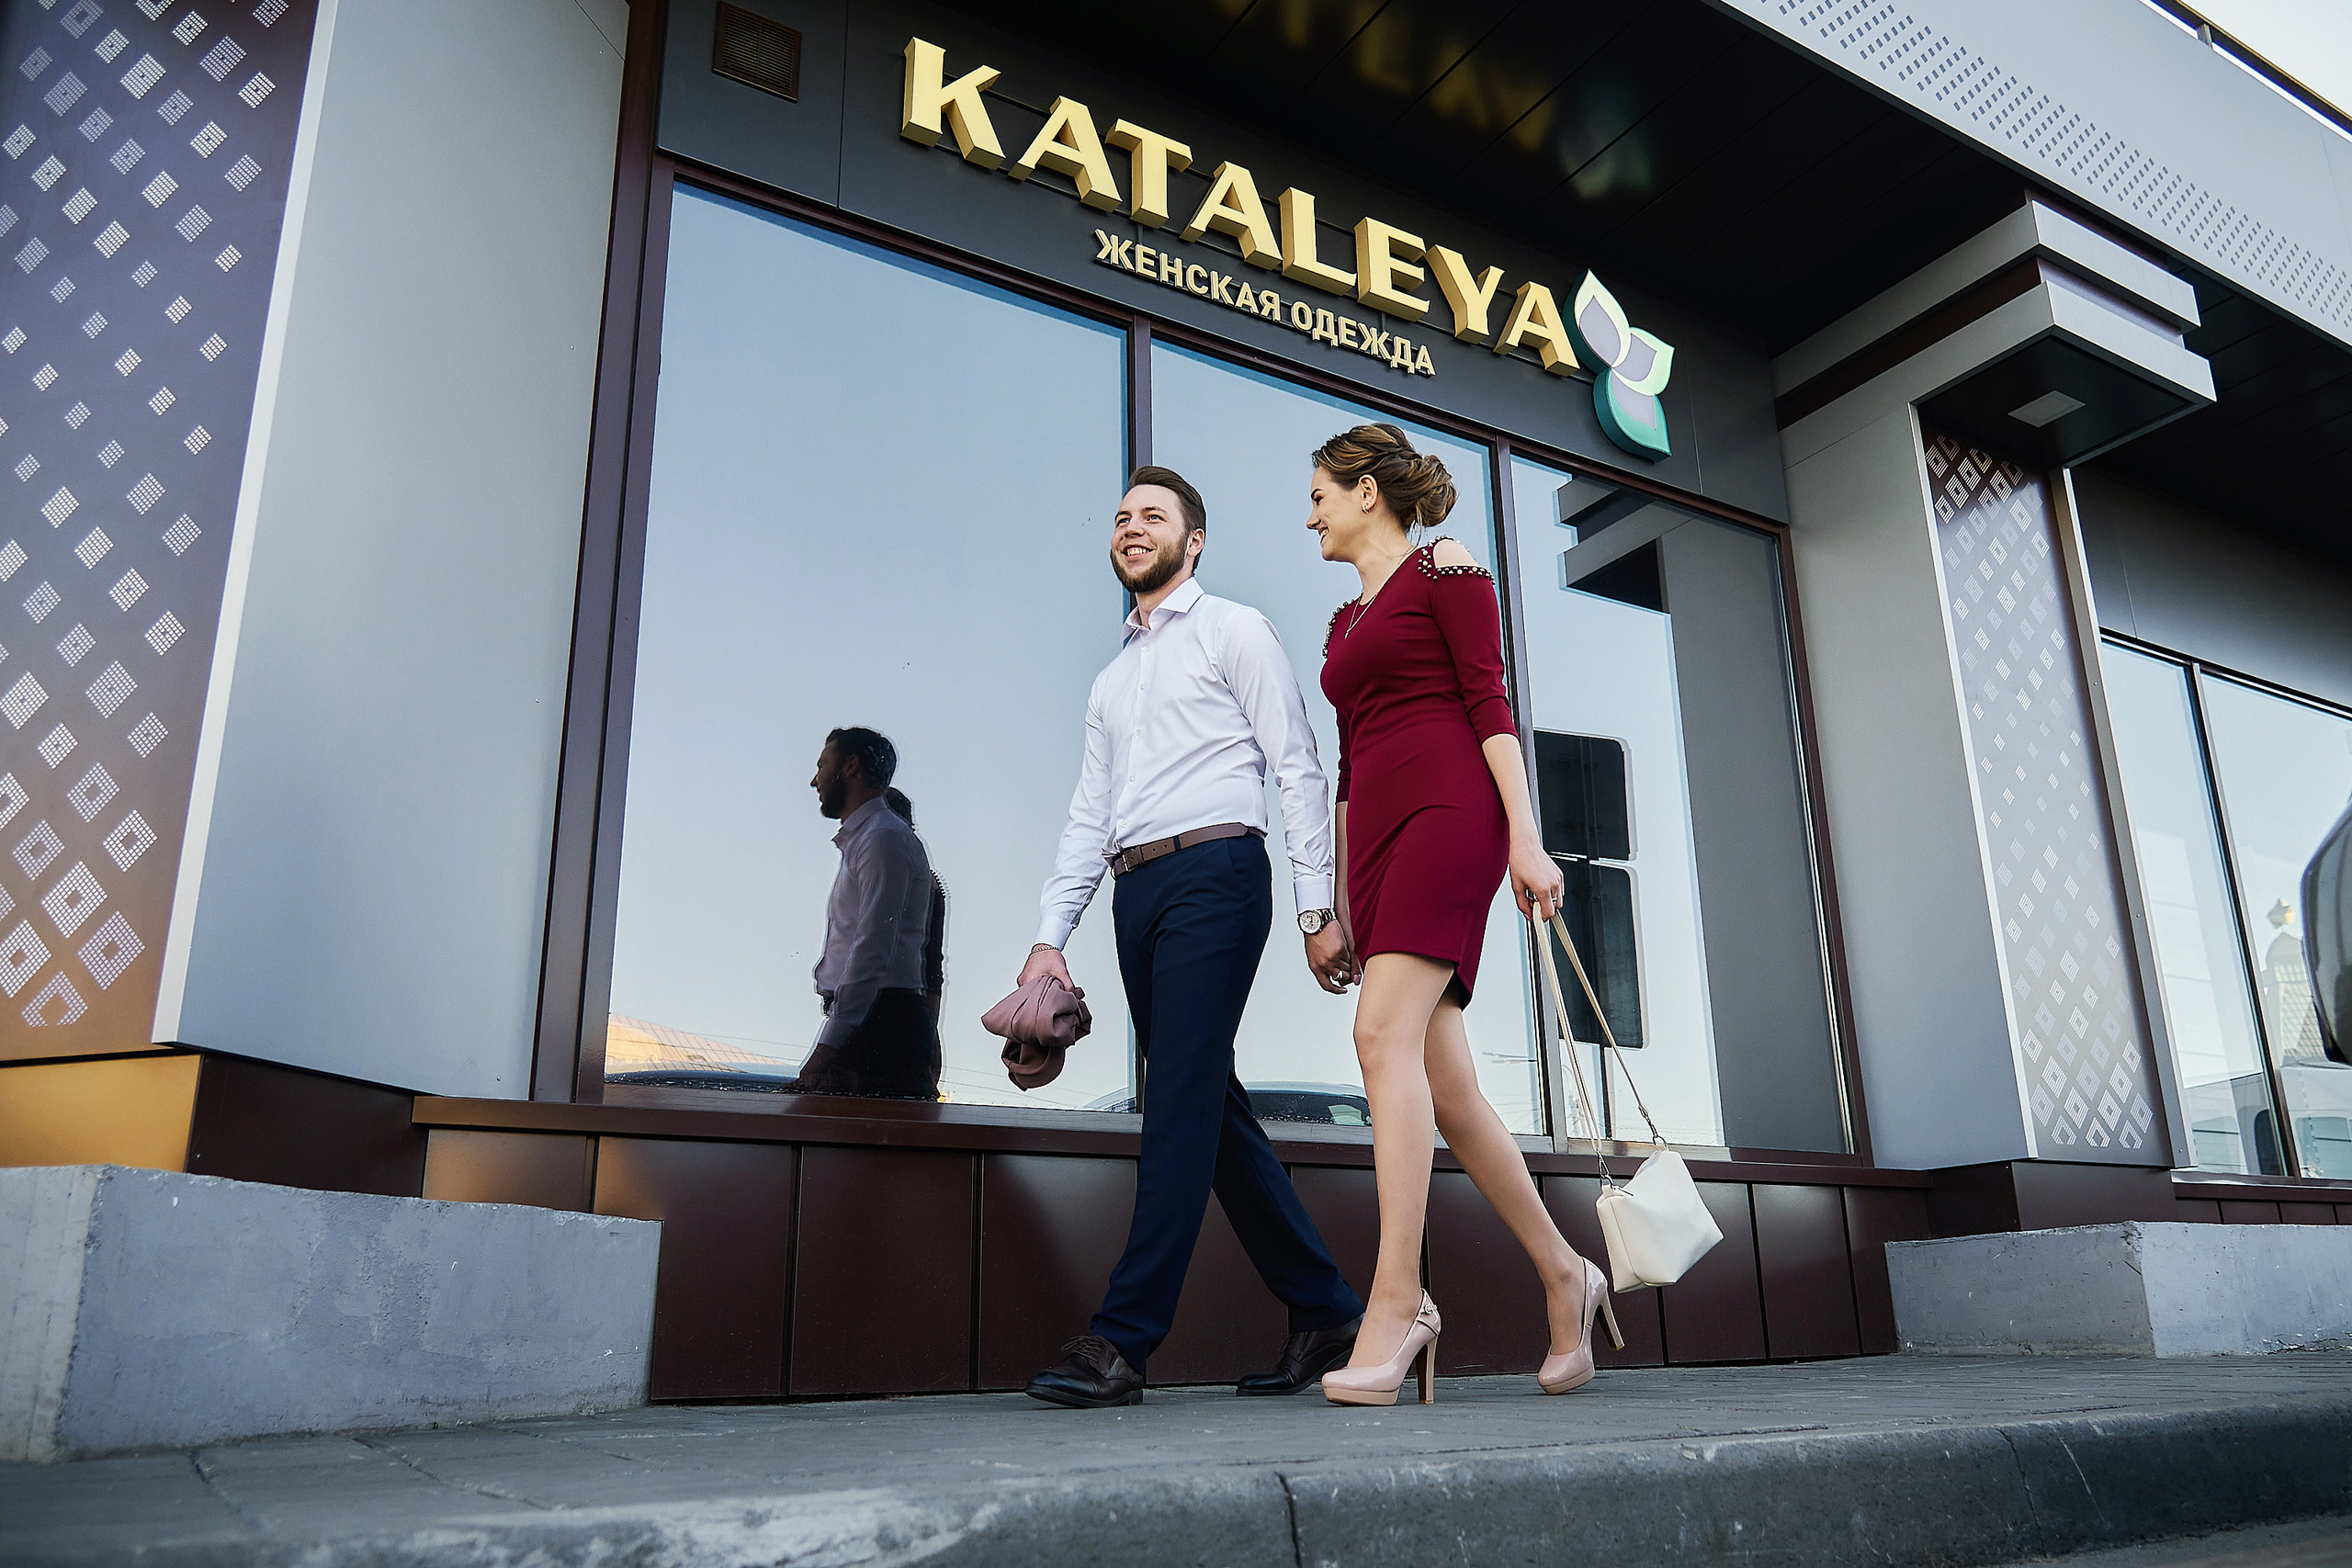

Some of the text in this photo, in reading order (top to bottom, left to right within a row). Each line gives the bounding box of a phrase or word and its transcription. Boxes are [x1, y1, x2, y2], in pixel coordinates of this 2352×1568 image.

[900, 37, 1581, 377] KATALEYA
[1094, 228, 1436, 377] ЖЕНСКАЯ ОДЕЖДА
